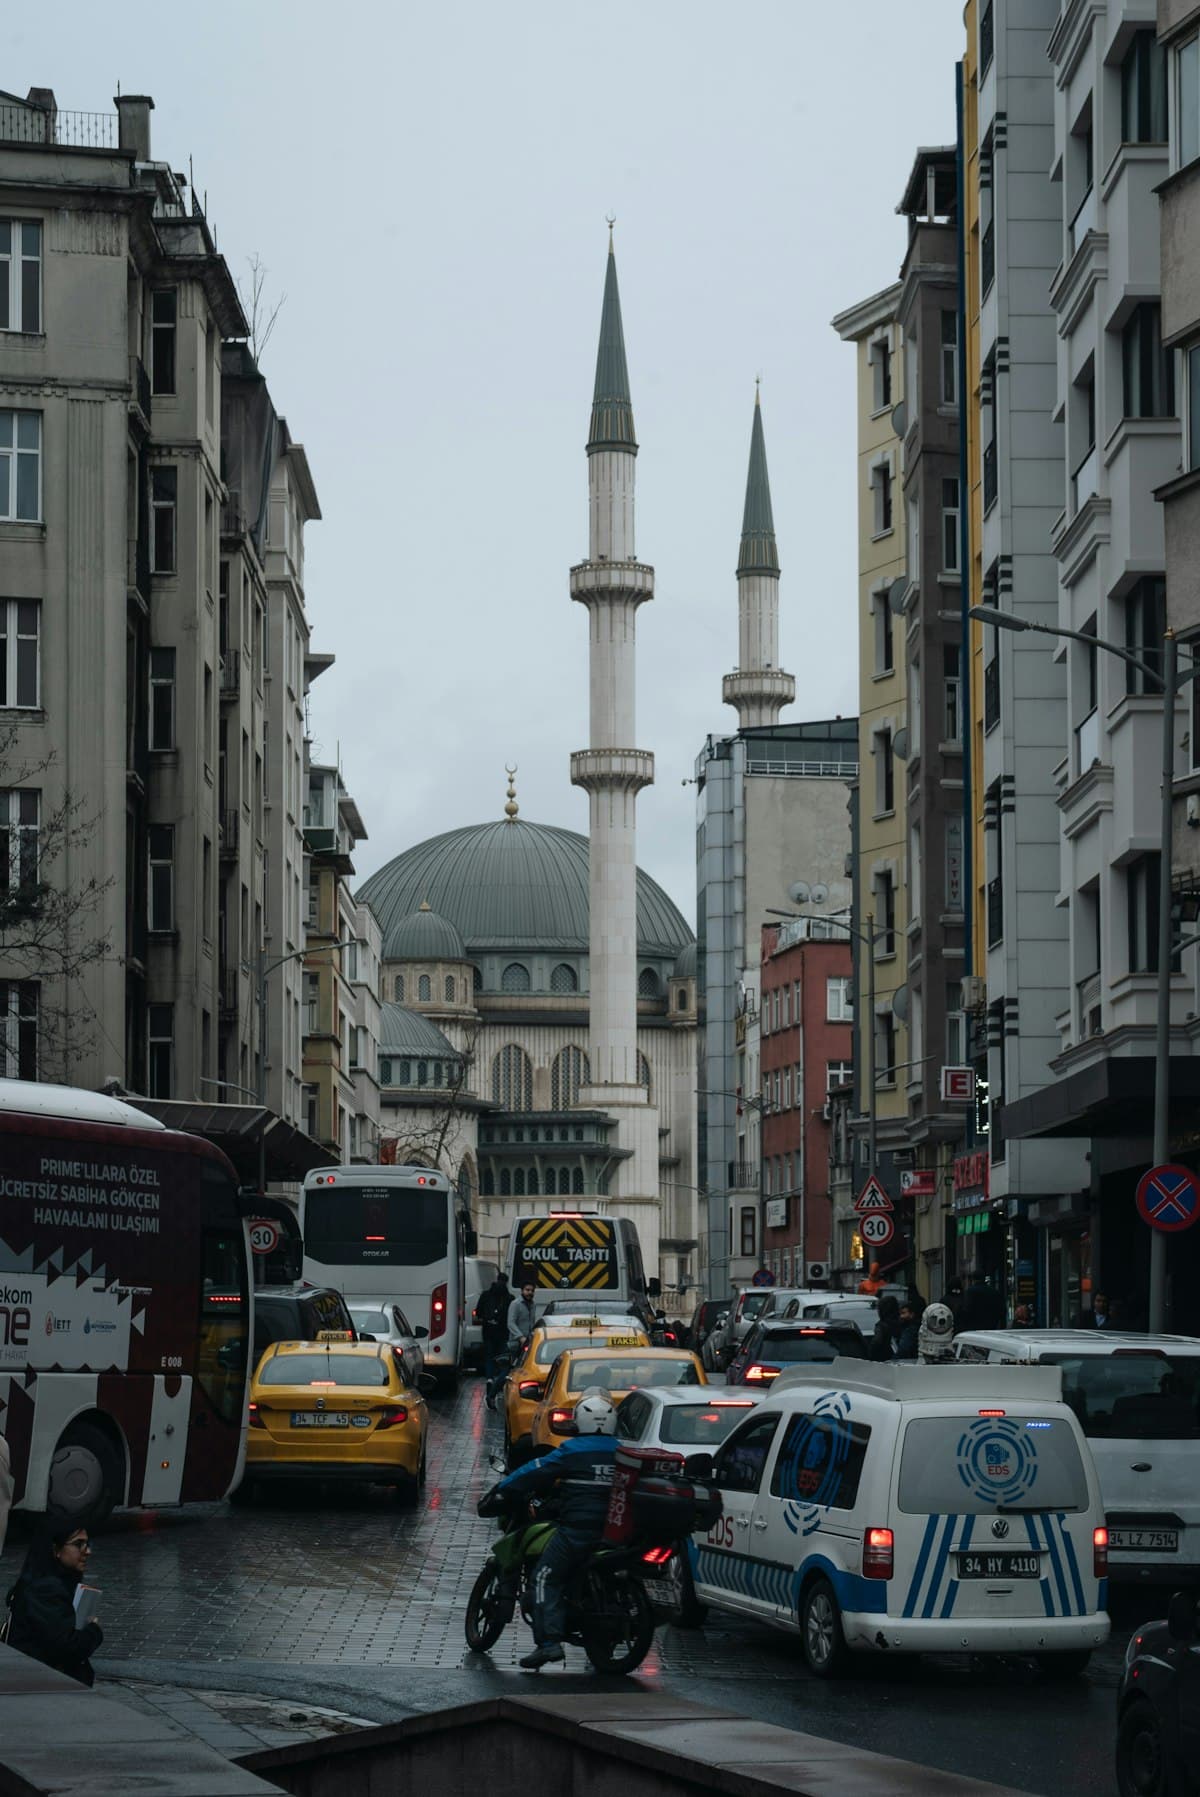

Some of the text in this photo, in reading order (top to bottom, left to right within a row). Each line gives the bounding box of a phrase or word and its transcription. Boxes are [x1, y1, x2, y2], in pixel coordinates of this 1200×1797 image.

[950, 1074, 968, 1095] E
[41, 1158, 160, 1186] PRIME'LILARA ÖZEL
[61, 1184, 107, 1205] SABİHA
[110, 1186, 160, 1213] GÖKÇEN
[34, 1207, 160, 1237] HAVAALANI ULAŞIMI
[866, 1220, 886, 1237] 30
[253, 1231, 271, 1245] 30
[522, 1247, 609, 1264] OKUL TAŞITI
[296, 1413, 306, 1423] 34
[312, 1413, 328, 1423] TCF
[336, 1413, 347, 1423] 45
[987, 1465, 1010, 1476] EDS
[1110, 1532, 1174, 1547] 34 LZ 7514
[965, 1558, 1037, 1572] 34 HY 4110
